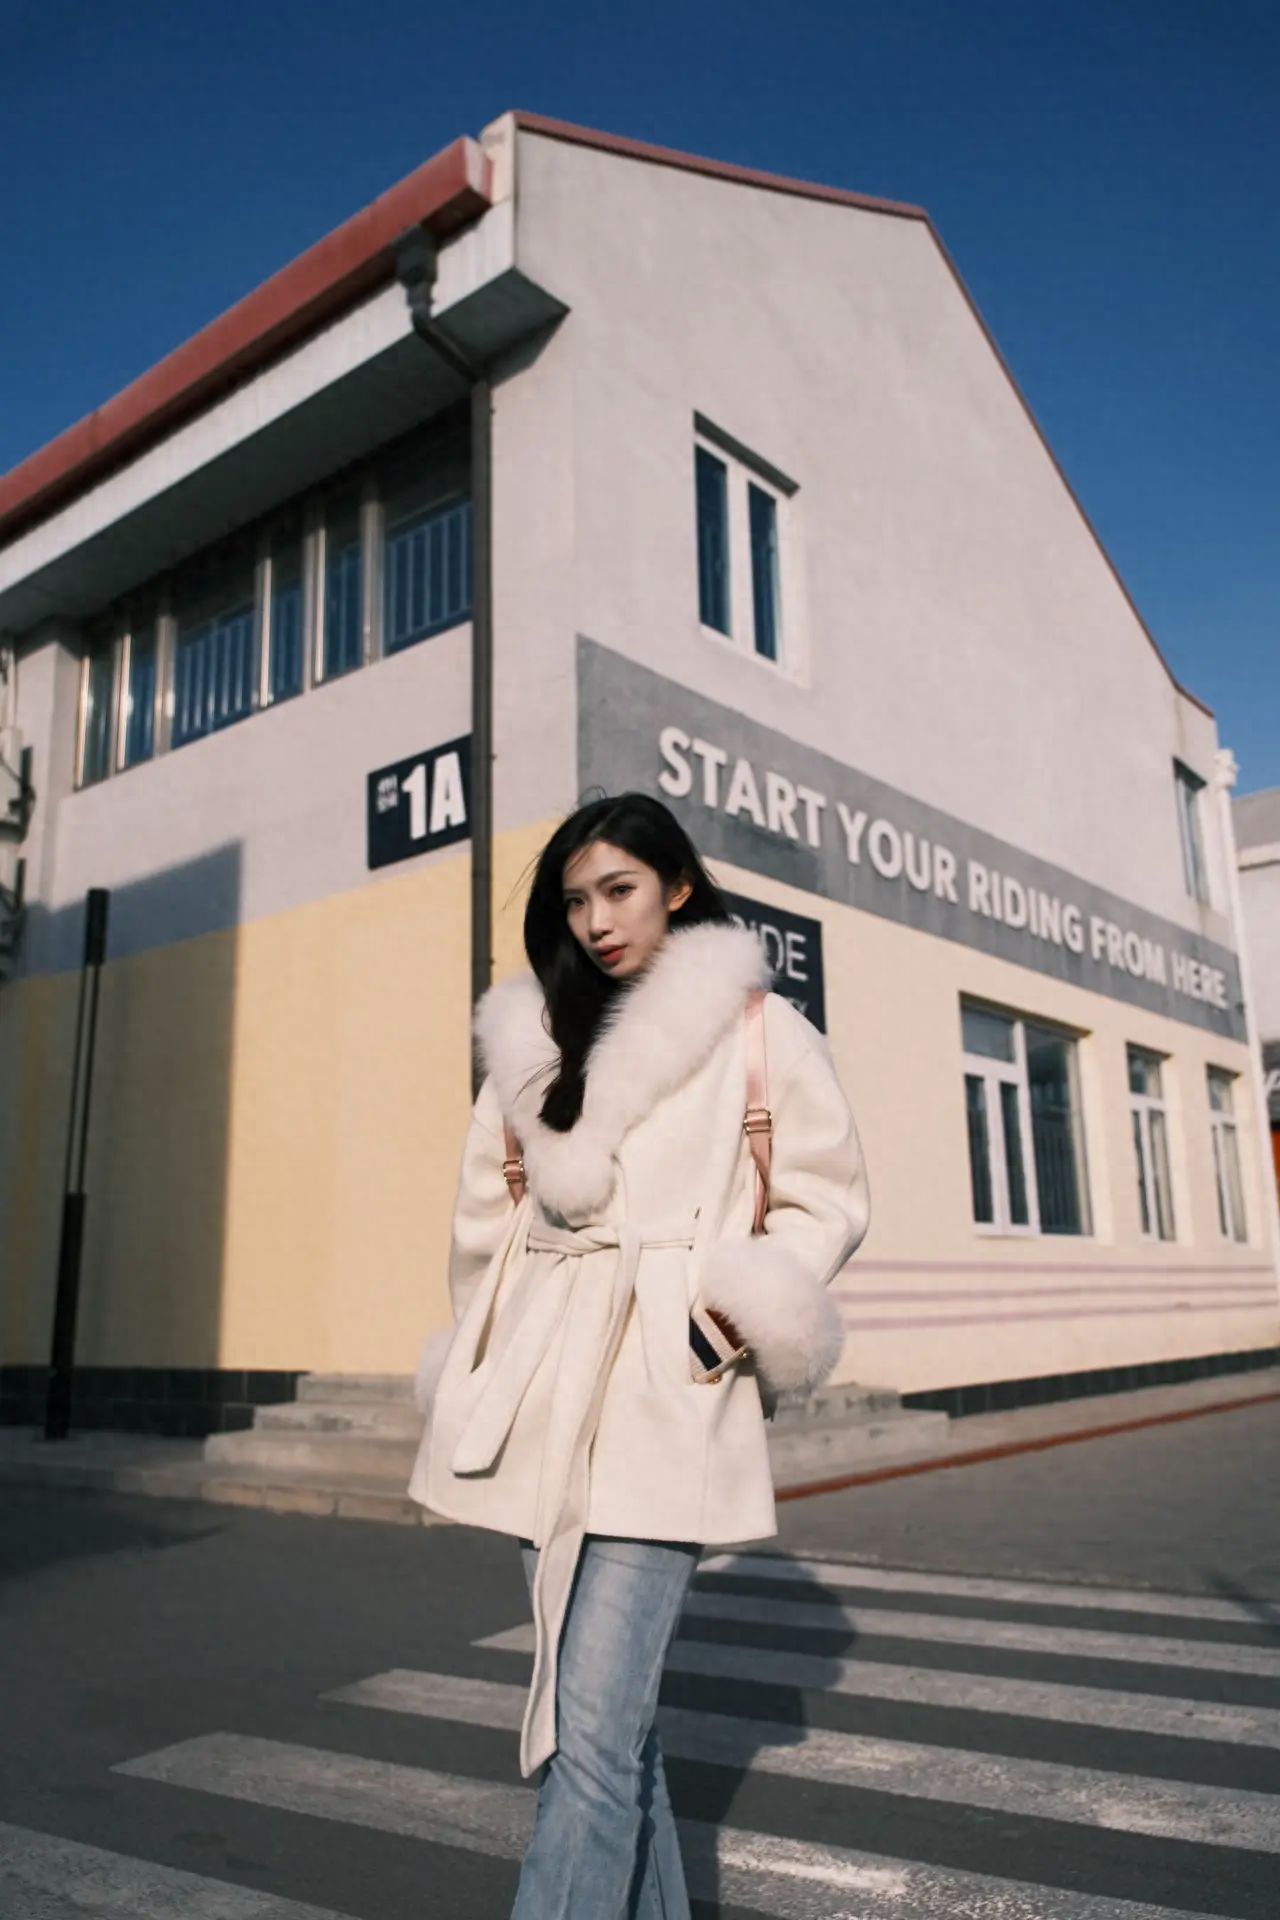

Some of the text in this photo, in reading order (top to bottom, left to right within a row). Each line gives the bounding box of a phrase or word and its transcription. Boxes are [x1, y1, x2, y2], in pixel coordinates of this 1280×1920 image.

[401, 751, 467, 840] 1A
[657, 726, 1230, 1010] START YOUR RIDING FROM HERE
